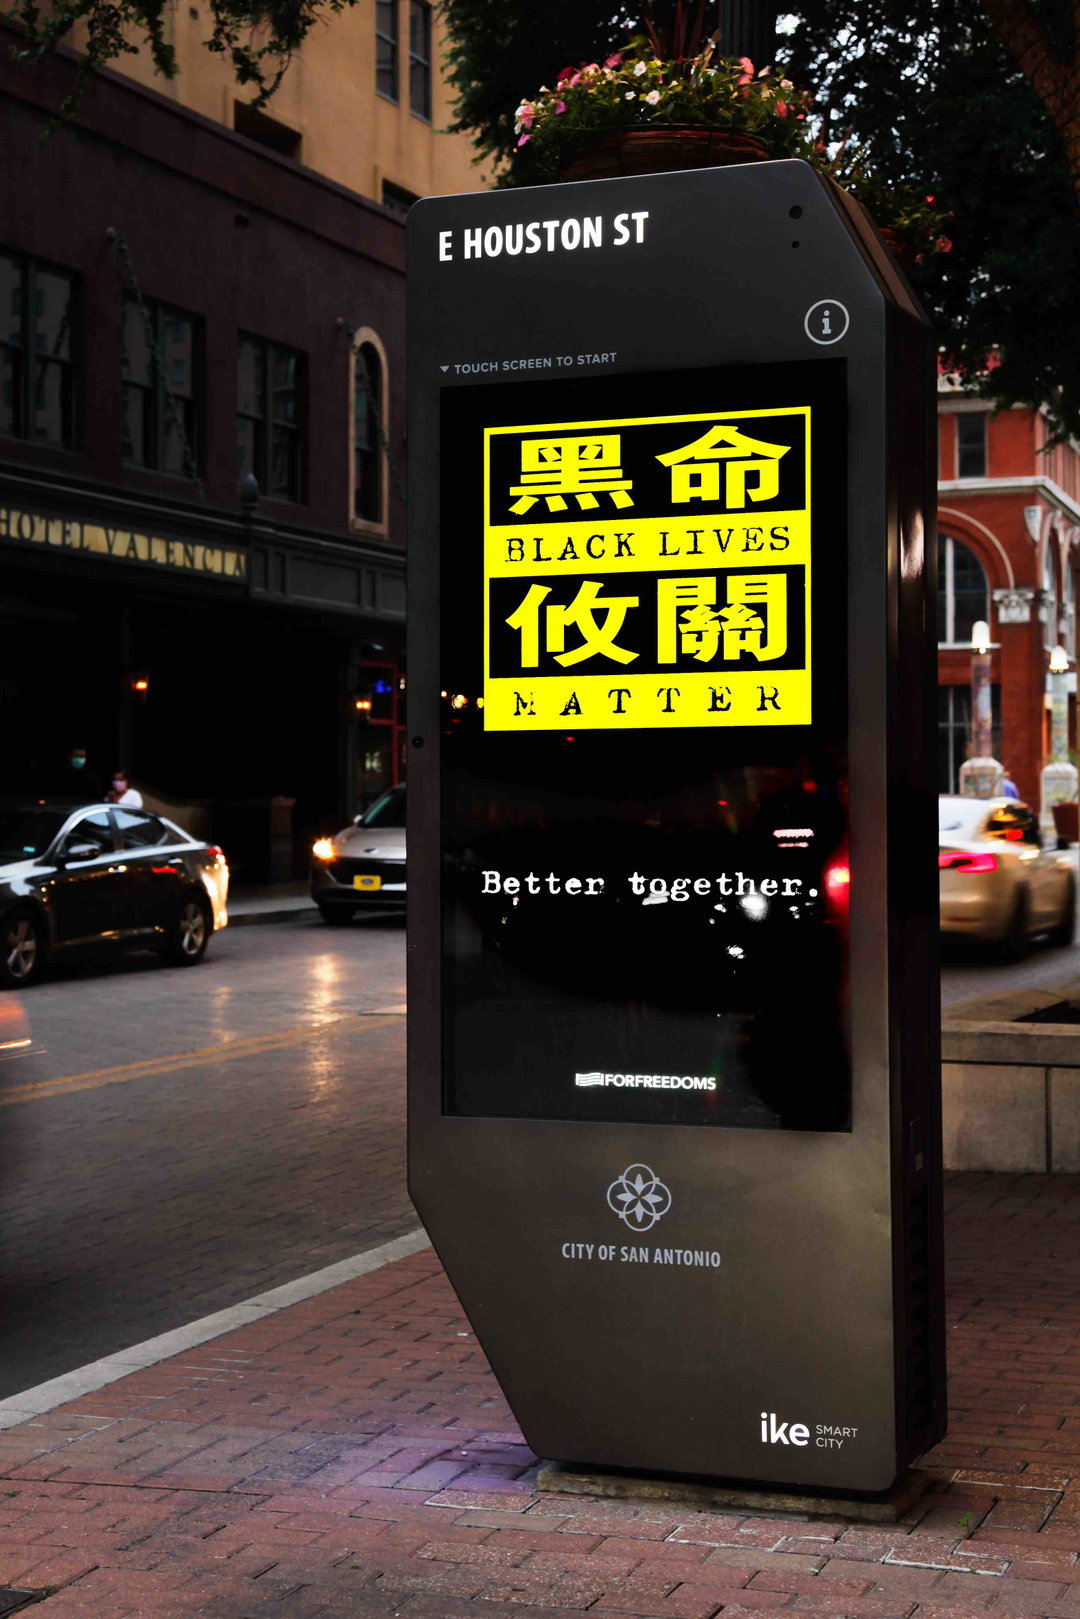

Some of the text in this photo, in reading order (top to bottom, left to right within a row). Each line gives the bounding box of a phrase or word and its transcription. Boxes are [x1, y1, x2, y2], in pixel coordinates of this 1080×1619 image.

[438, 210, 650, 262] E HOUSTON ST
[454, 352, 617, 375] TOUCH SCREEN TO START
[507, 424, 792, 516] 黑命
[0, 507, 246, 577] HOTEL VALENCIA
[504, 525, 790, 563] BLACK LIVES
[504, 573, 788, 668] 攸關
[513, 685, 782, 717] MATTER
[481, 870, 819, 902] Better together.
[604, 1073, 717, 1091] FORFREEDOMS
[561, 1242, 721, 1268] CITY OF SAN ANTONIO
[760, 1412, 859, 1447] ike SMART
[815, 1437, 844, 1450] CITY
